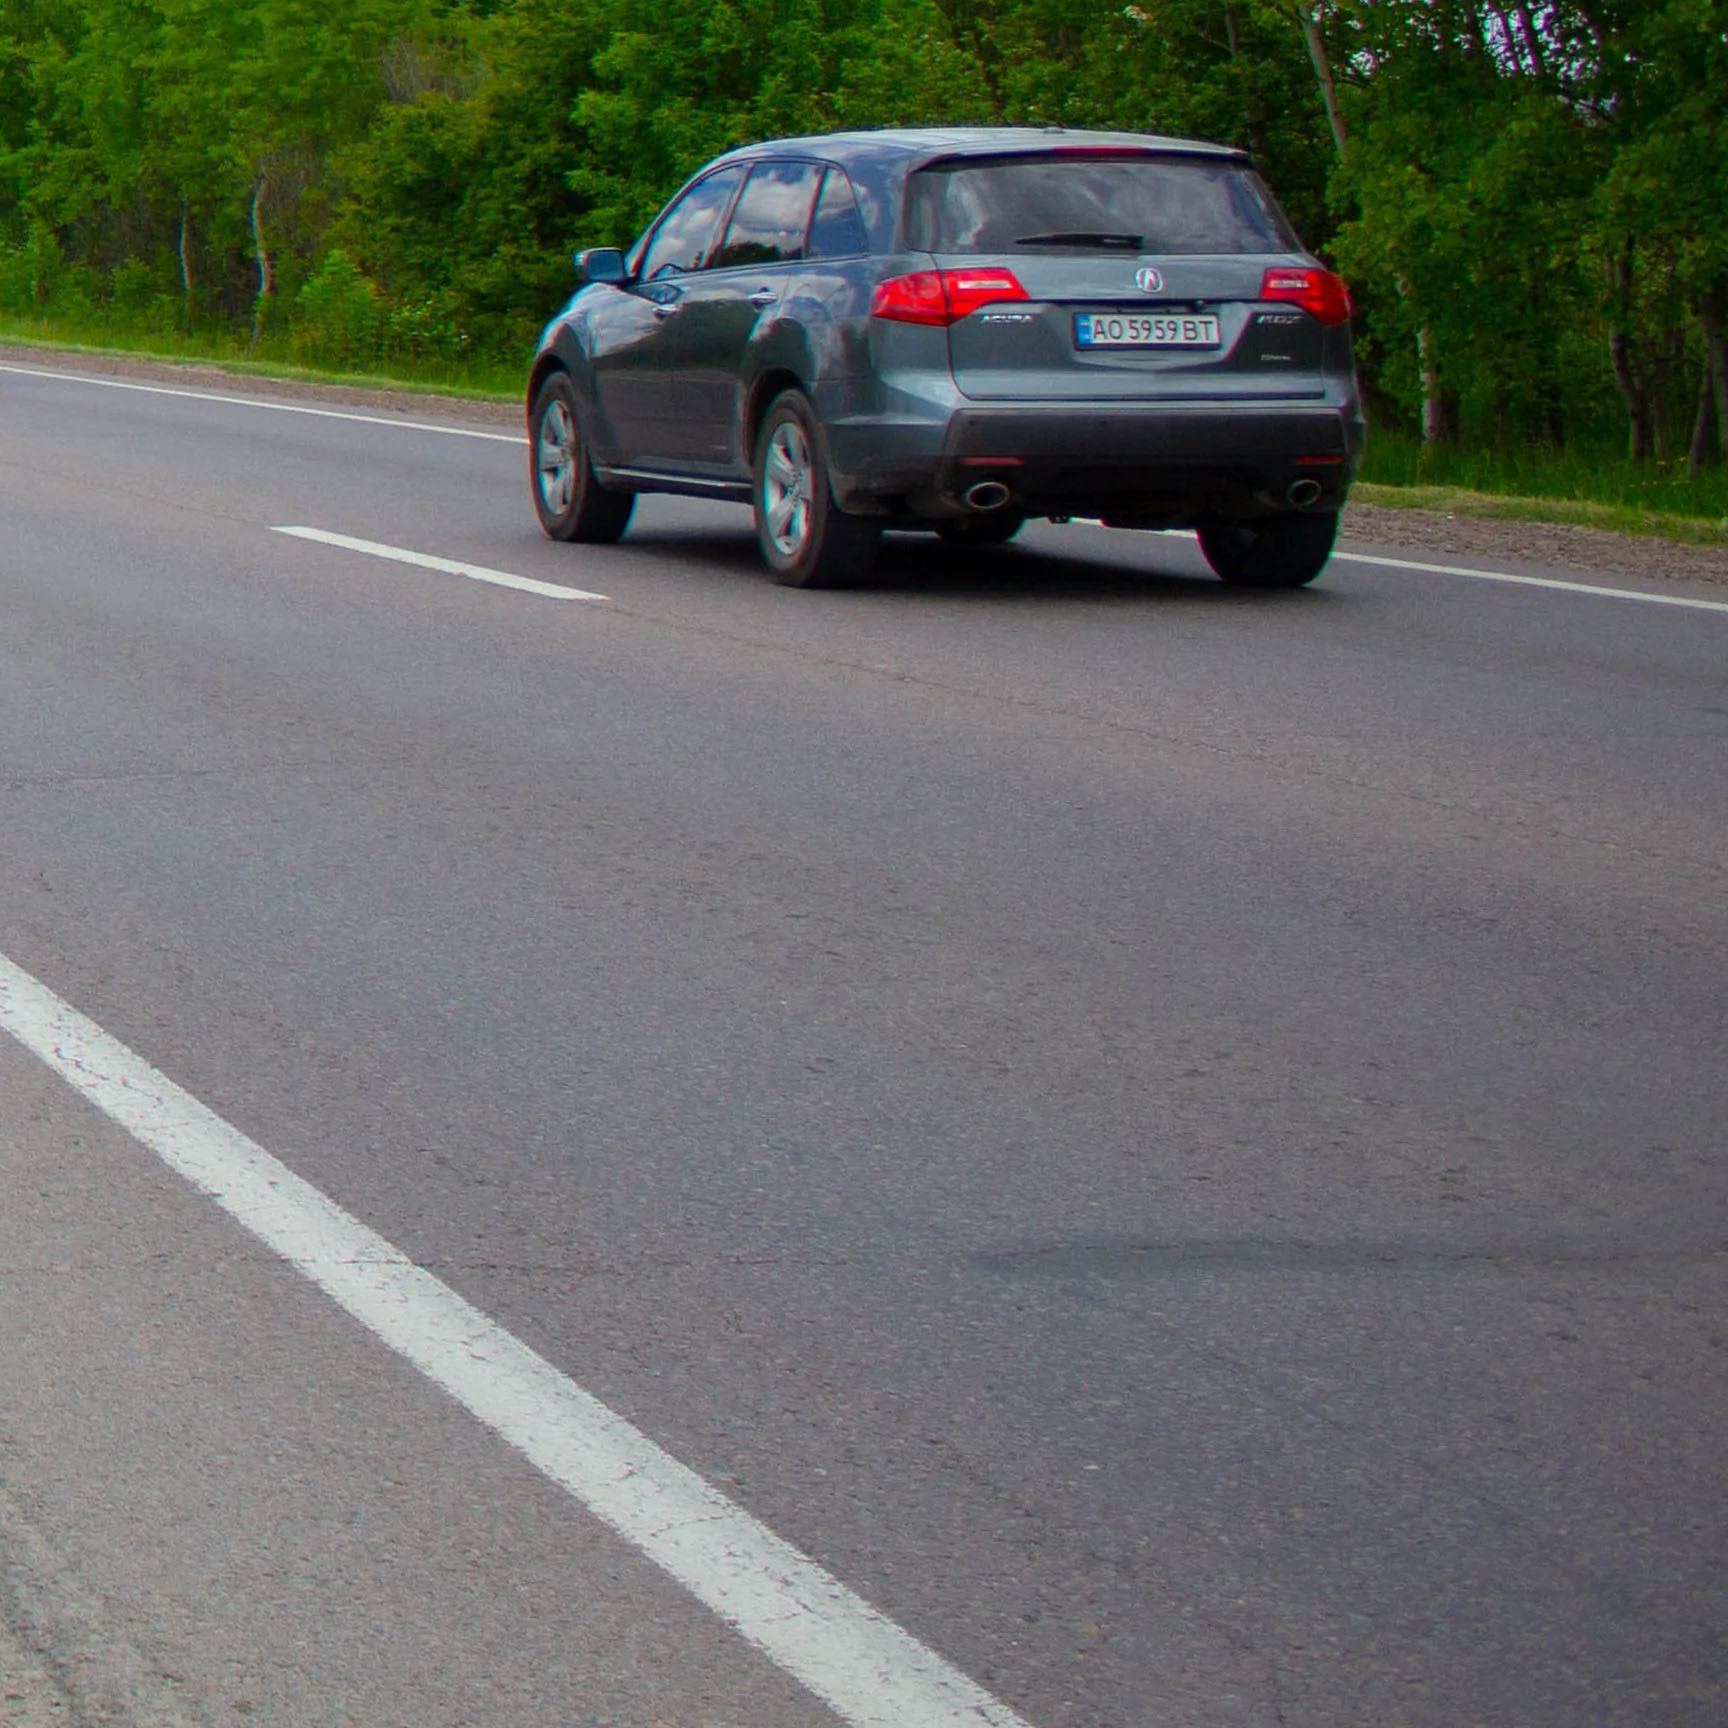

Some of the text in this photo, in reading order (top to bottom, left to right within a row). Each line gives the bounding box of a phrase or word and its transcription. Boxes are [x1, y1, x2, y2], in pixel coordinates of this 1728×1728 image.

[980, 315, 1034, 324] ACURA
[1093, 319, 1214, 341] AO 5959 BT
